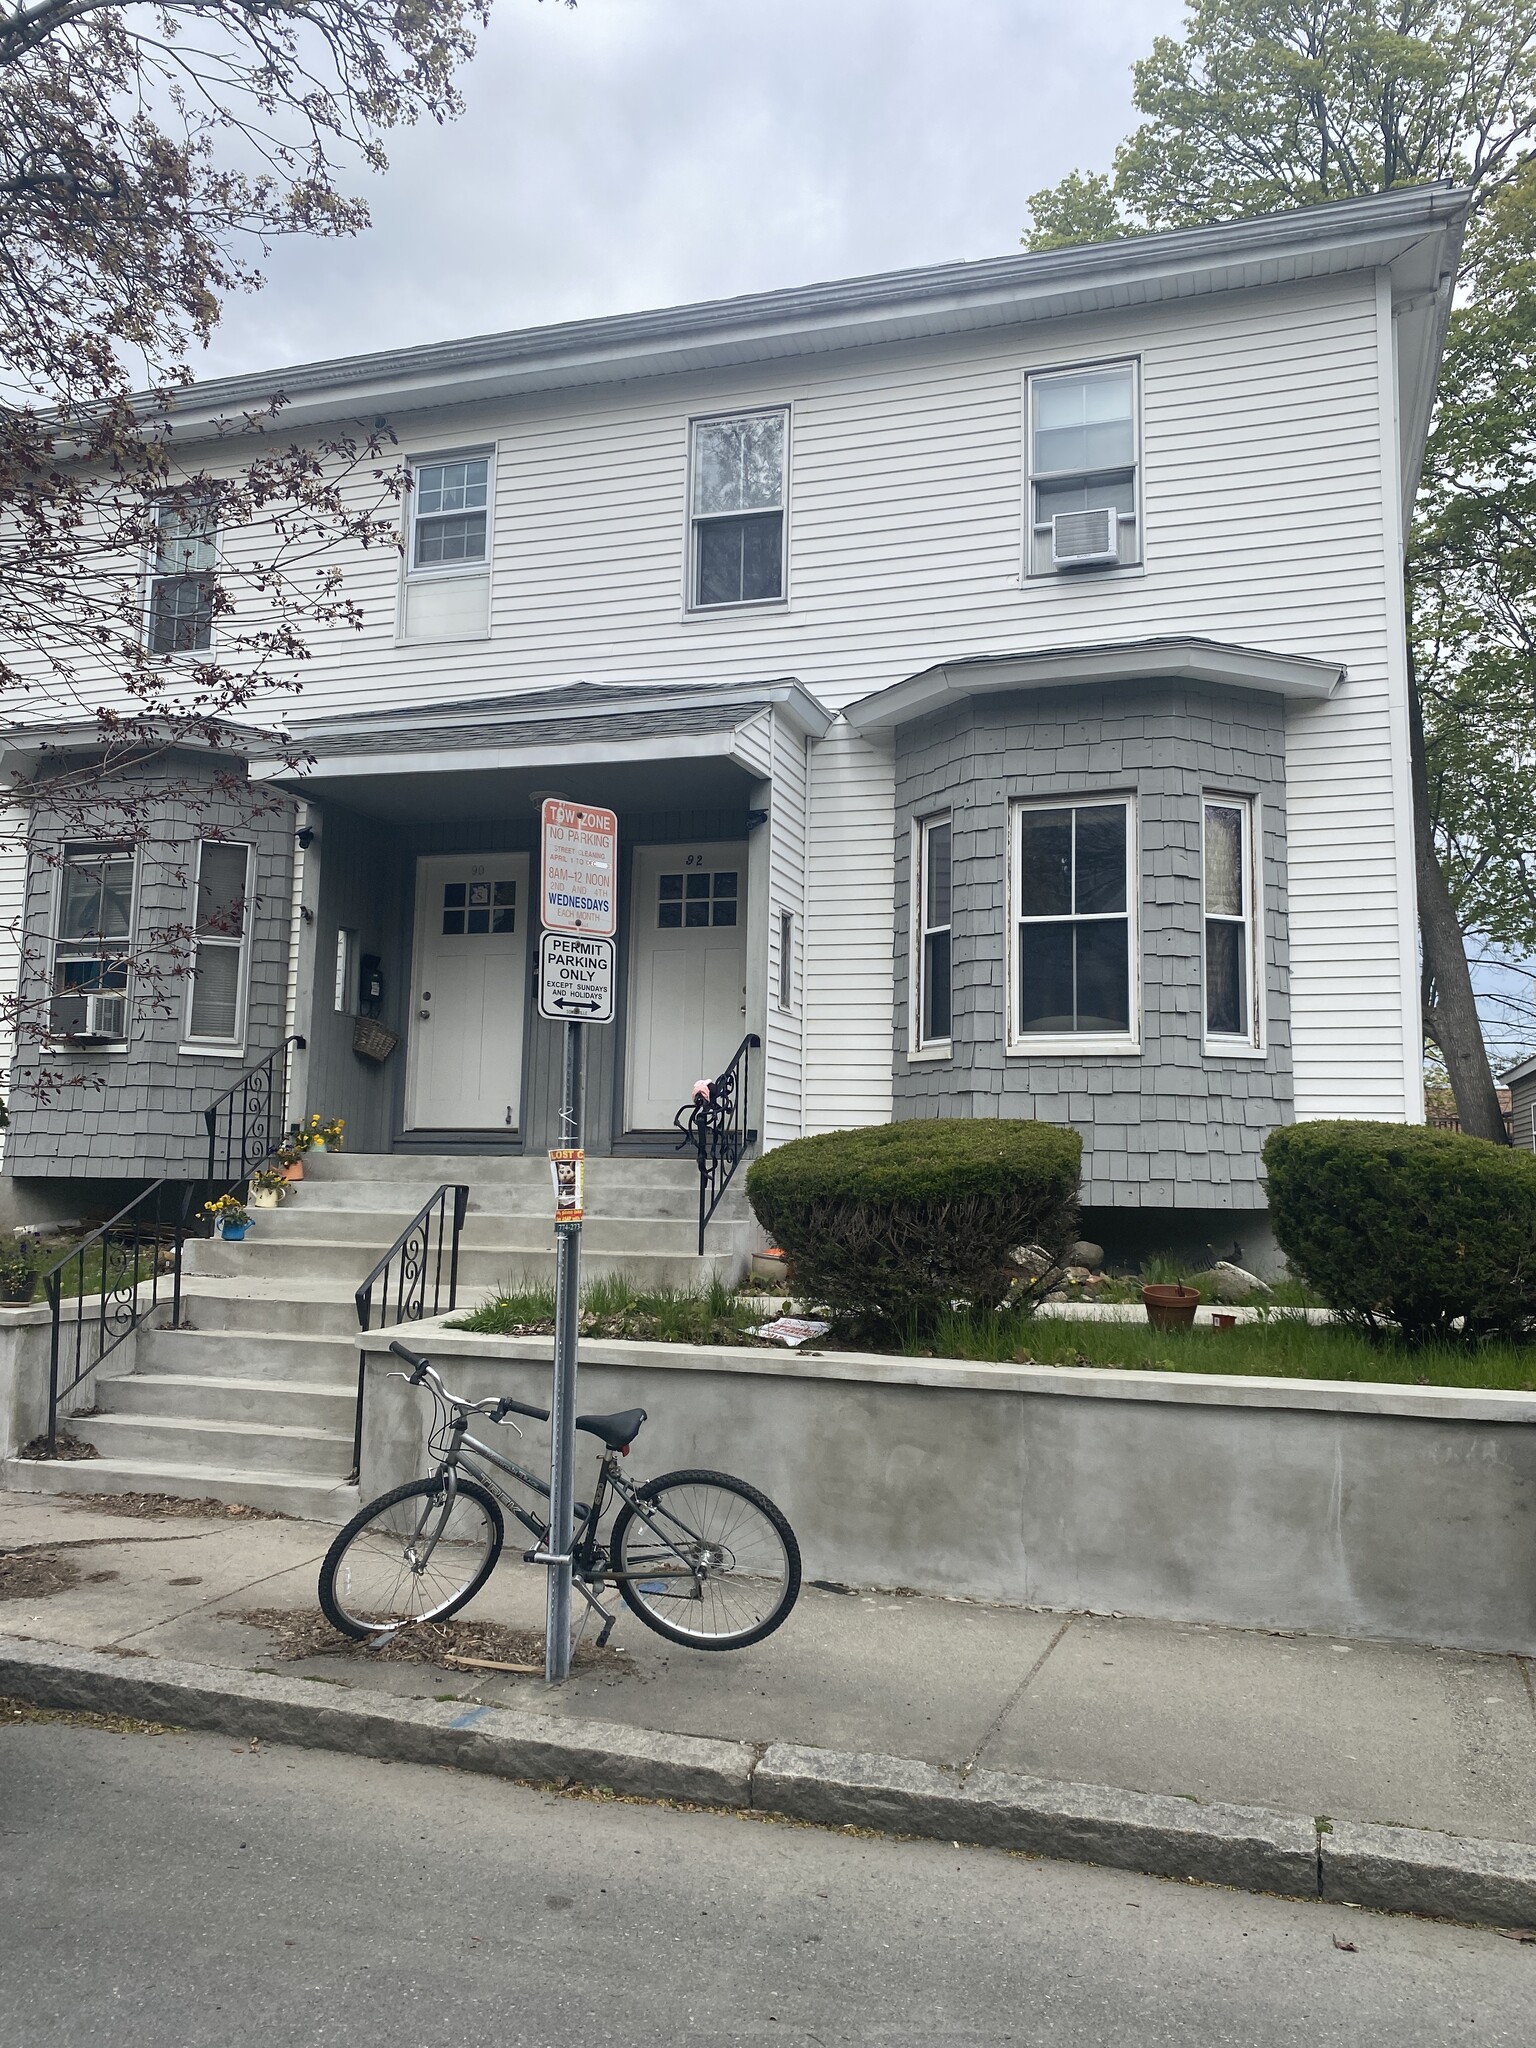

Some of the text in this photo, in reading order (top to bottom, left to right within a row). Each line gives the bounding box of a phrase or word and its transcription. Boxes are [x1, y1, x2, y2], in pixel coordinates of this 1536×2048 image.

[550, 806, 611, 830] TOW ZONE
[550, 827, 610, 848] NO PARKING
[550, 854, 568, 863] APRIL
[554, 845, 606, 860] STREET CLEANING
[686, 854, 703, 866] 92
[471, 865, 485, 876] 90
[586, 872, 610, 887] NOON
[550, 882, 608, 897] 2ND AND 4TH
[548, 892, 609, 912] WEDNESDAYS
[557, 908, 600, 921] EACH MONTH
[553, 940, 603, 956] PERMIT
[548, 953, 608, 970] PARKING
[560, 968, 595, 982] ONLY
[547, 980, 608, 993] EXCEPT SUNDAYS
[570, 991, 603, 1000] HOLIDAYS
[551, 1151, 575, 1160] LOST
[480, 1472, 522, 1514] TREK
